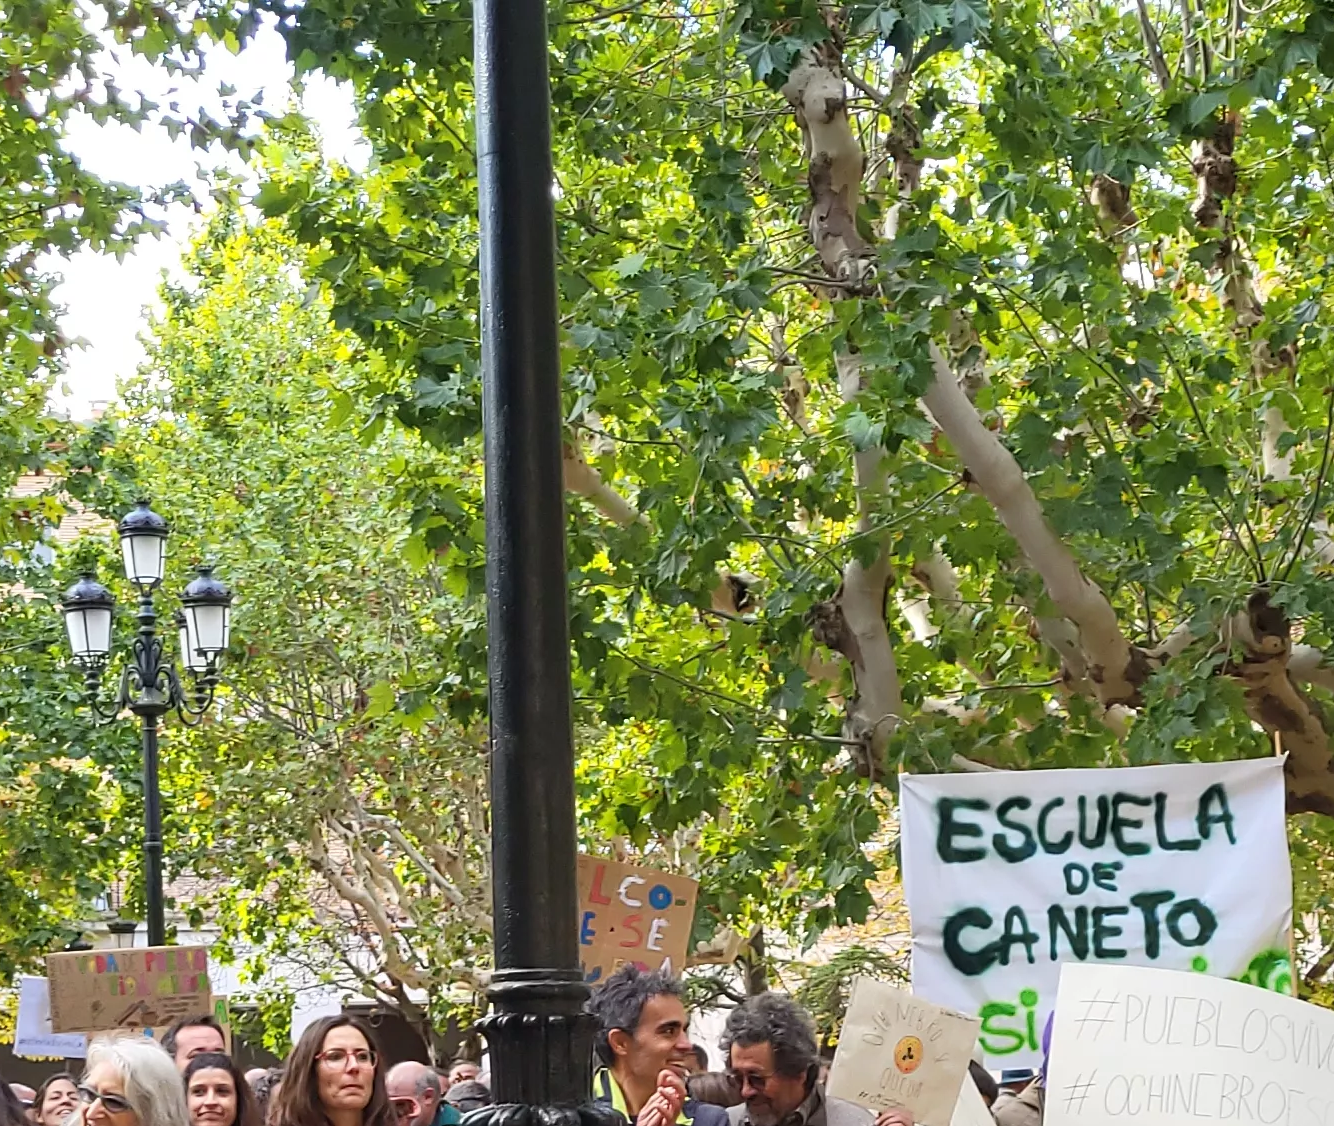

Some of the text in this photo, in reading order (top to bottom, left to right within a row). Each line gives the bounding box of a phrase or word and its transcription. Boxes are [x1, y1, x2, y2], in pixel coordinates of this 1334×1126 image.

[936, 781, 1236, 864] ESCUELA
[1062, 860, 1124, 895] DE
[942, 889, 1218, 976] CANETO
